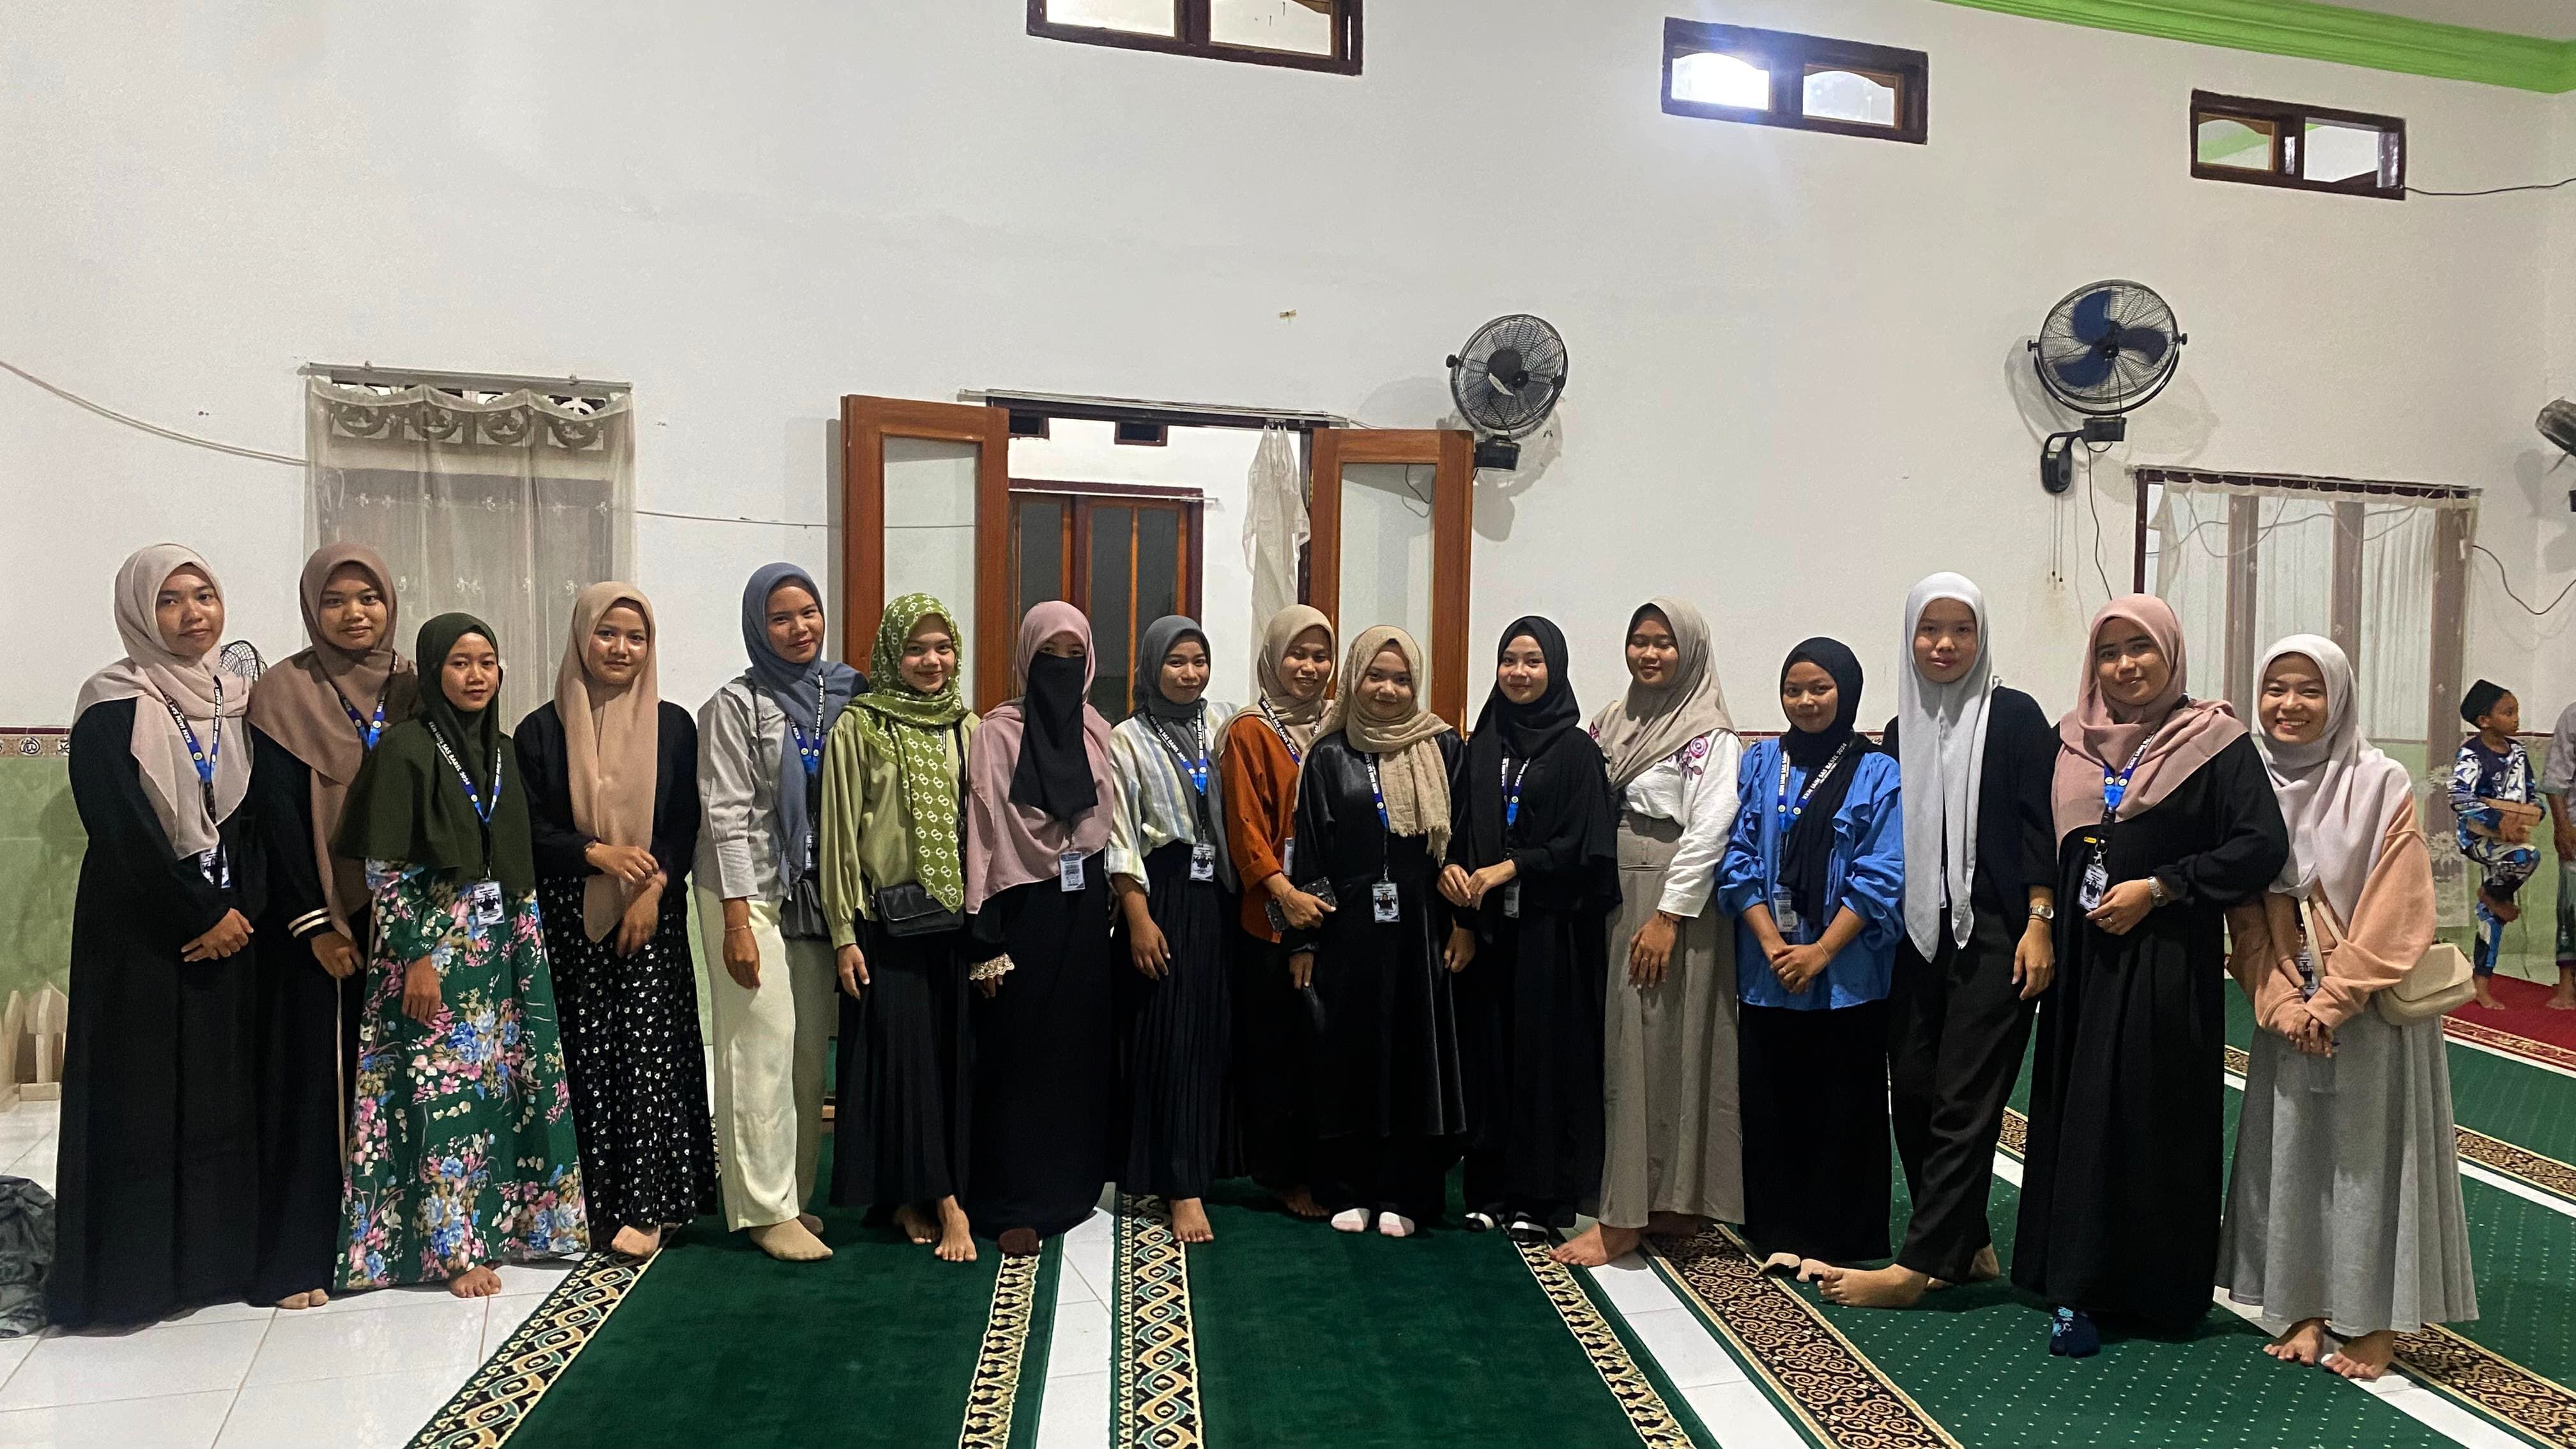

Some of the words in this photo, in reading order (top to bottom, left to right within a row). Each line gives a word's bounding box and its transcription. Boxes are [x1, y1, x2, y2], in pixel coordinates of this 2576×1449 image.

[175, 715, 185, 728] IAIN
[182, 729, 192, 743] KKN
[1278, 728, 1288, 742] BABEL
[1167, 739, 1178, 752] BABEL
[441, 744, 451, 754] SAS
[448, 754, 461, 771] BABEL
[459, 771, 470, 785] 2024
[2126, 756, 2137, 769] KKN
[1802, 788, 1813, 799] KKN
[1810, 778, 1821, 788] IAIN
[1818, 769, 1827, 778] SAS
[1825, 755, 1838, 769] BABEL
[1836, 742, 1846, 755] 2024
